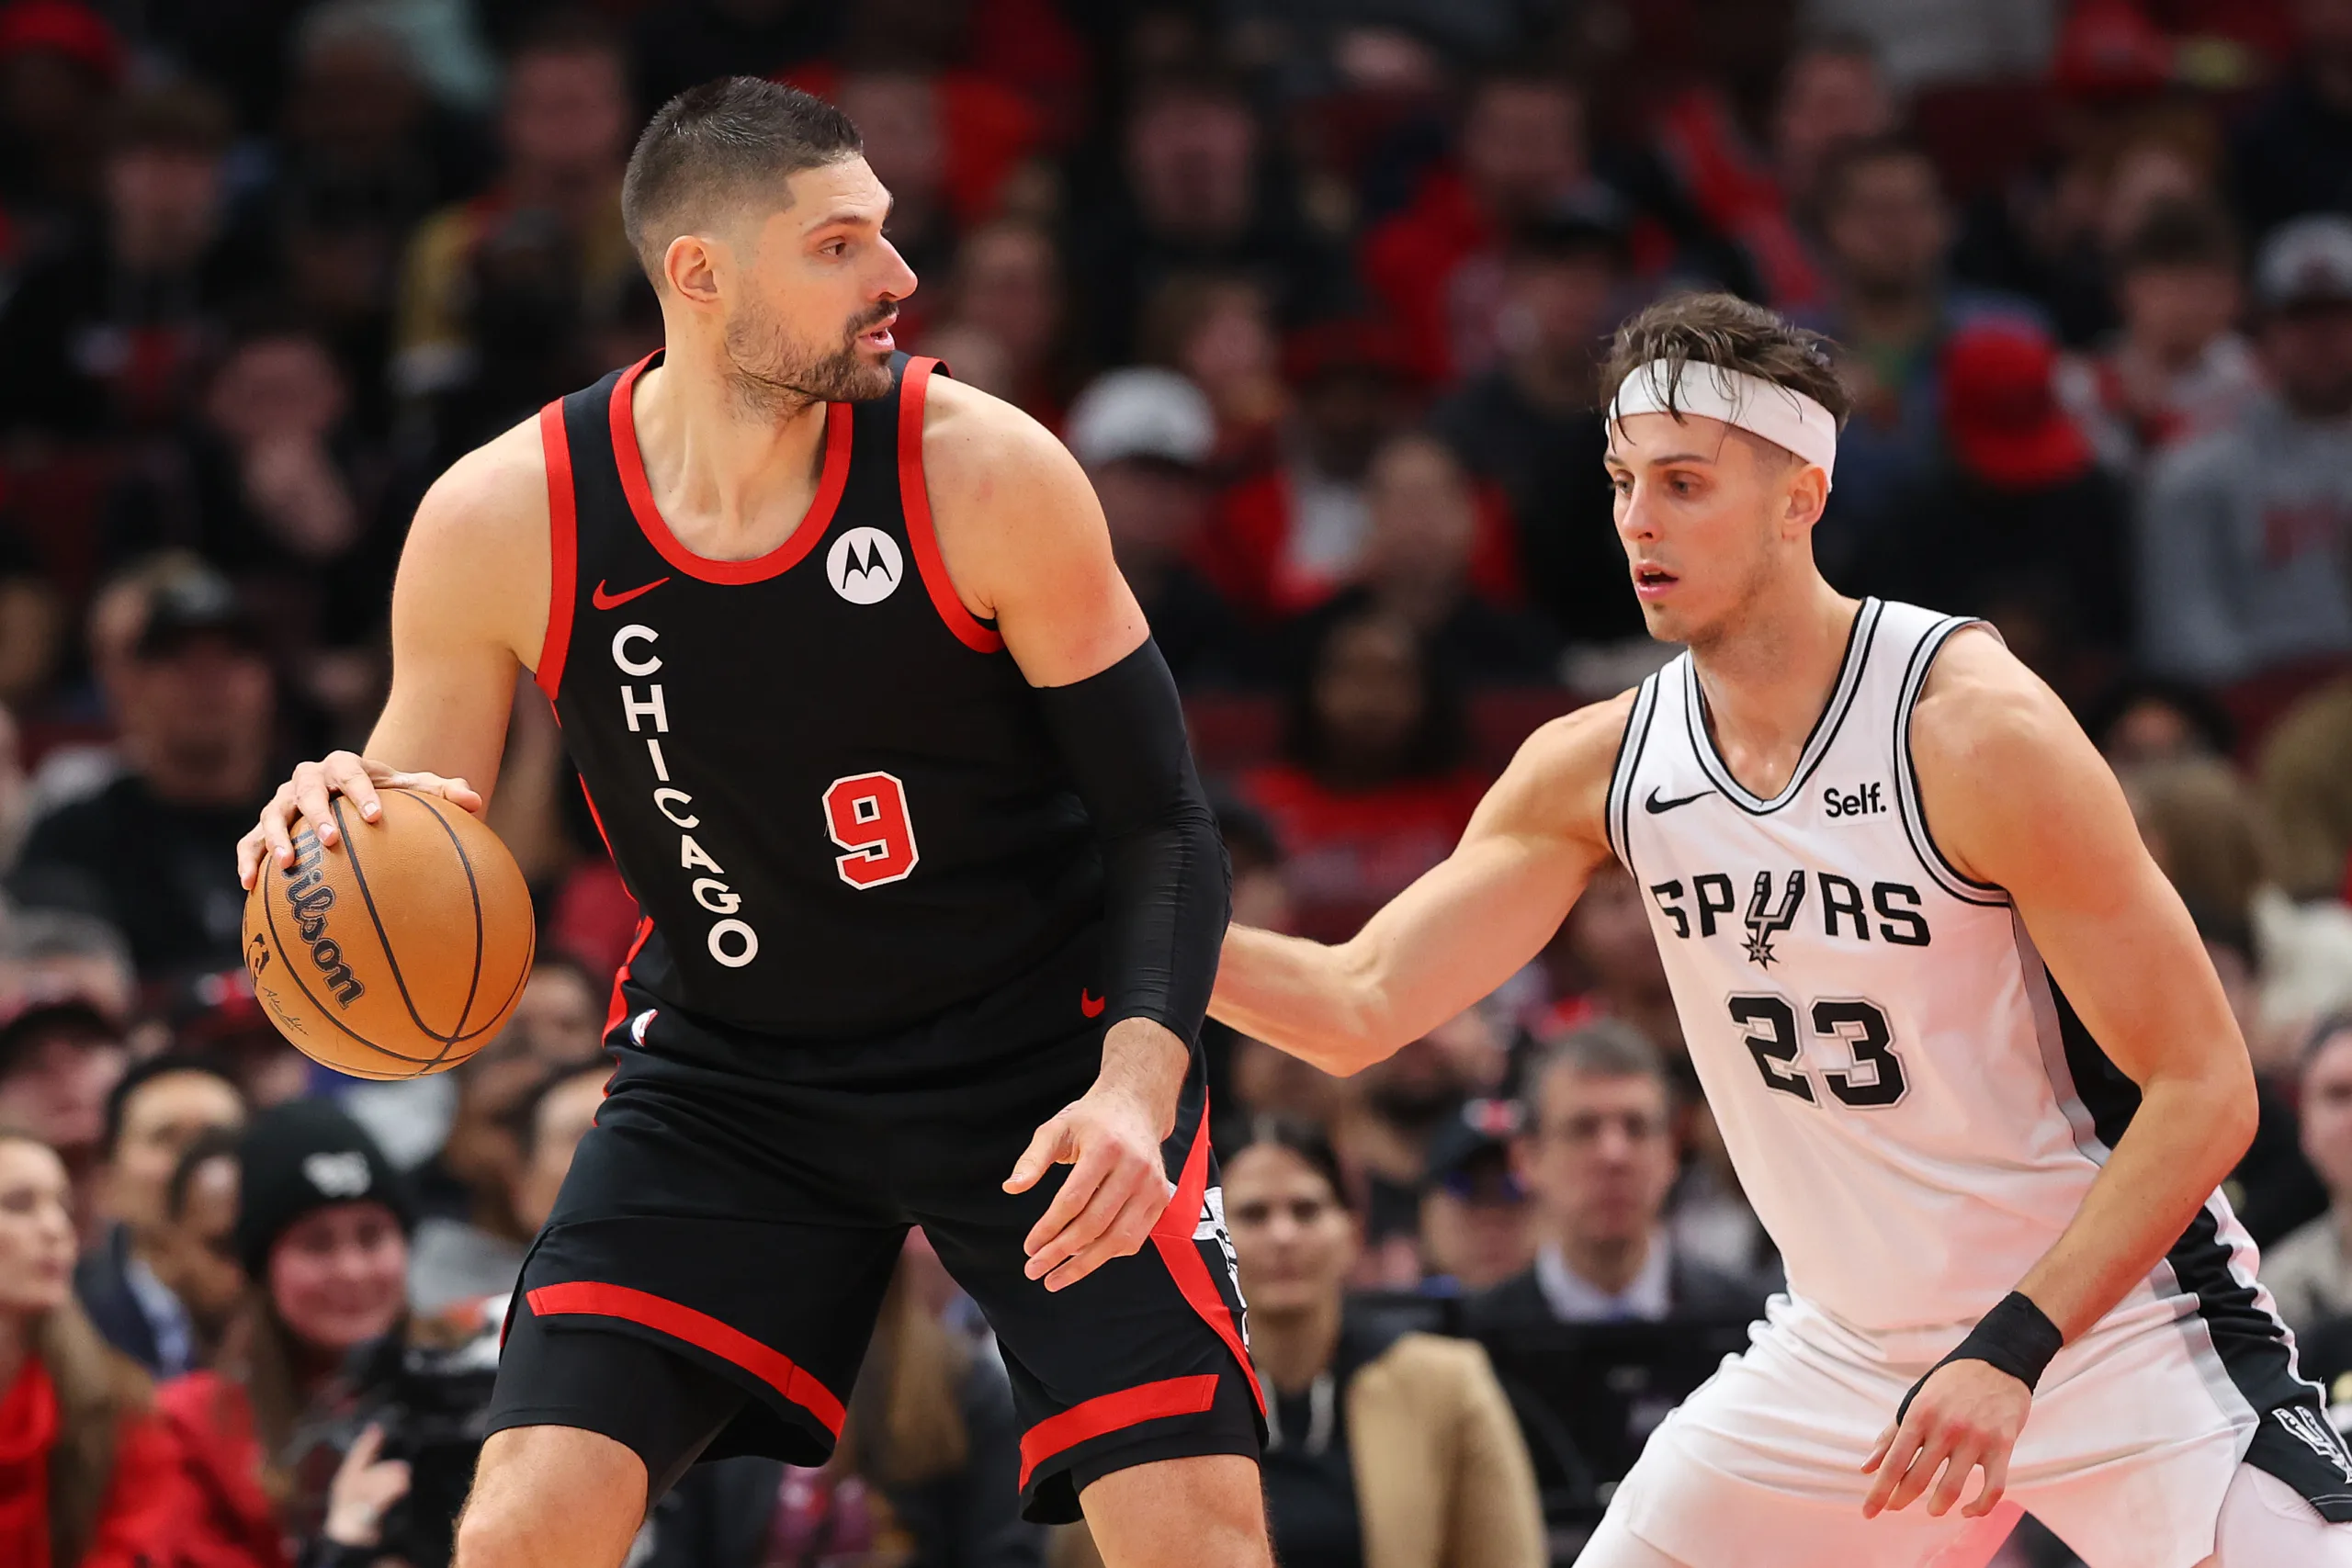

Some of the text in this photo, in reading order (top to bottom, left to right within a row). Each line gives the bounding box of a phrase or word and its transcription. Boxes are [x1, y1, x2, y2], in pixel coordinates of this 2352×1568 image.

[612, 624, 759, 967] CHICAGO
[822, 771, 920, 890] 9
[1823, 782, 1887, 818] Self.
[1650, 869, 1931, 969] SPURS
[1724, 990, 1911, 1111] 23
